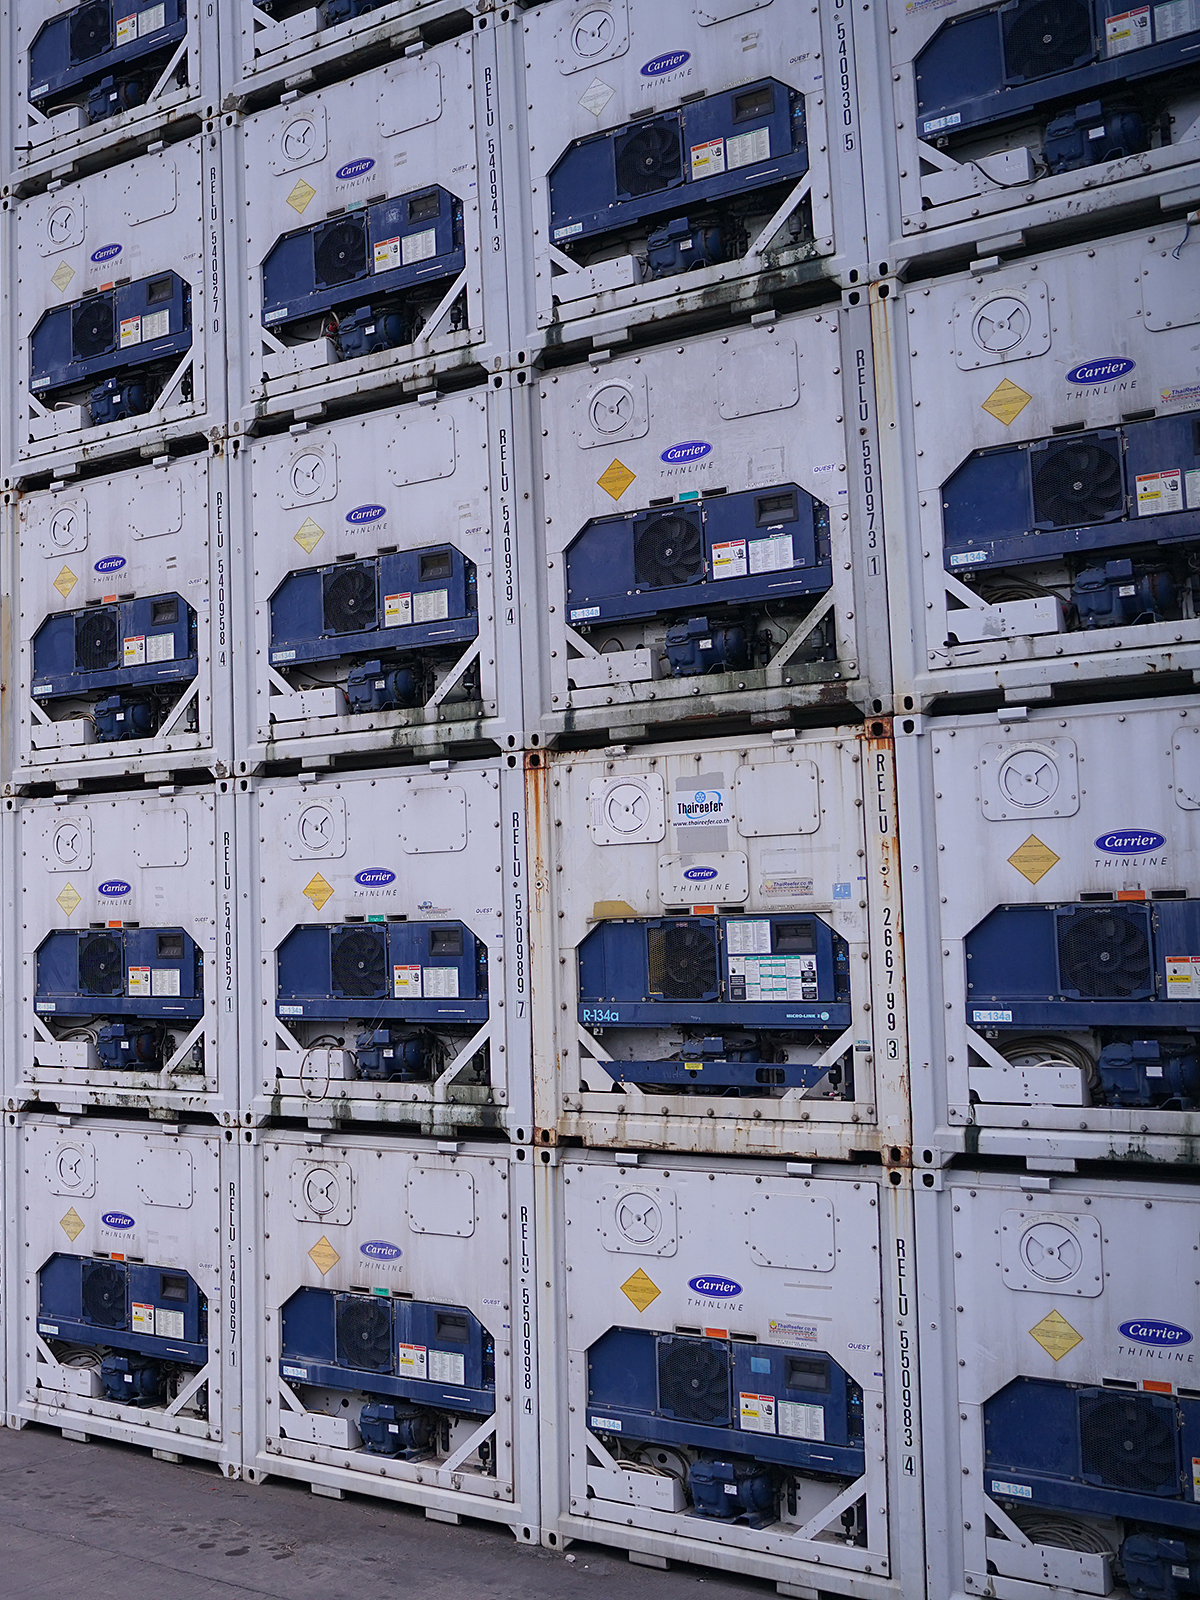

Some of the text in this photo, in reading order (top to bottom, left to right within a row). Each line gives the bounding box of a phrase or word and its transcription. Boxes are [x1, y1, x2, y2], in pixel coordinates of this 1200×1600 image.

[647, 53, 686, 73] Carrier
[640, 68, 692, 91] THINLINE
[837, 24, 853, 150] 540930 5
[925, 115, 960, 131] R-134a
[485, 68, 500, 251] RELU 540941 3
[341, 160, 372, 176] Carrier
[335, 174, 377, 192] THINLINE
[93, 247, 119, 260] Carrier
[90, 259, 123, 273] THINLINE
[213, 320, 218, 332] 0
[1076, 361, 1127, 379] Carrier
[1066, 381, 1138, 400] THINLINE
[668, 443, 707, 459] Carrier
[813, 464, 835, 473] QUEST
[857, 350, 877, 574] RELU 550973 1
[660, 462, 714, 478] THINLINE
[351, 508, 382, 521] Carrier
[345, 523, 387, 535] THINLINE
[500, 430, 514, 623] RELU 540939 4
[98, 559, 123, 571] Carrier
[93, 573, 127, 583] THINLINE
[220, 653, 226, 665] 4
[678, 801, 723, 814] Thaireefer
[1105, 833, 1157, 848] Carrier
[1095, 857, 1168, 868] THINLINE
[360, 871, 391, 882] Carrier
[102, 883, 128, 893] Carrier
[354, 889, 396, 897] THINLINE
[877, 754, 896, 1058] RELU 266799 3
[512, 812, 524, 1017] RELU 550989 7
[227, 997, 231, 1012] 1
[583, 1010, 619, 1021] R-134a
[974, 1011, 1011, 1021] R-134a
[105, 1214, 131, 1225] Carrier
[101, 1230, 135, 1240] THINLINE
[366, 1244, 398, 1256] Carrier
[359, 1261, 403, 1272] THINLINE
[695, 1278, 737, 1293] Carrier
[521, 1207, 532, 1413] RELU 550998 4
[688, 1299, 743, 1310] THINLINE
[1129, 1322, 1183, 1341] Carrier
[232, 1351, 235, 1365] 1
[897, 1239, 914, 1475] RELU 550983 4
[1118, 1346, 1194, 1363] THINLINE
[993, 1482, 1031, 1497] R-134a
